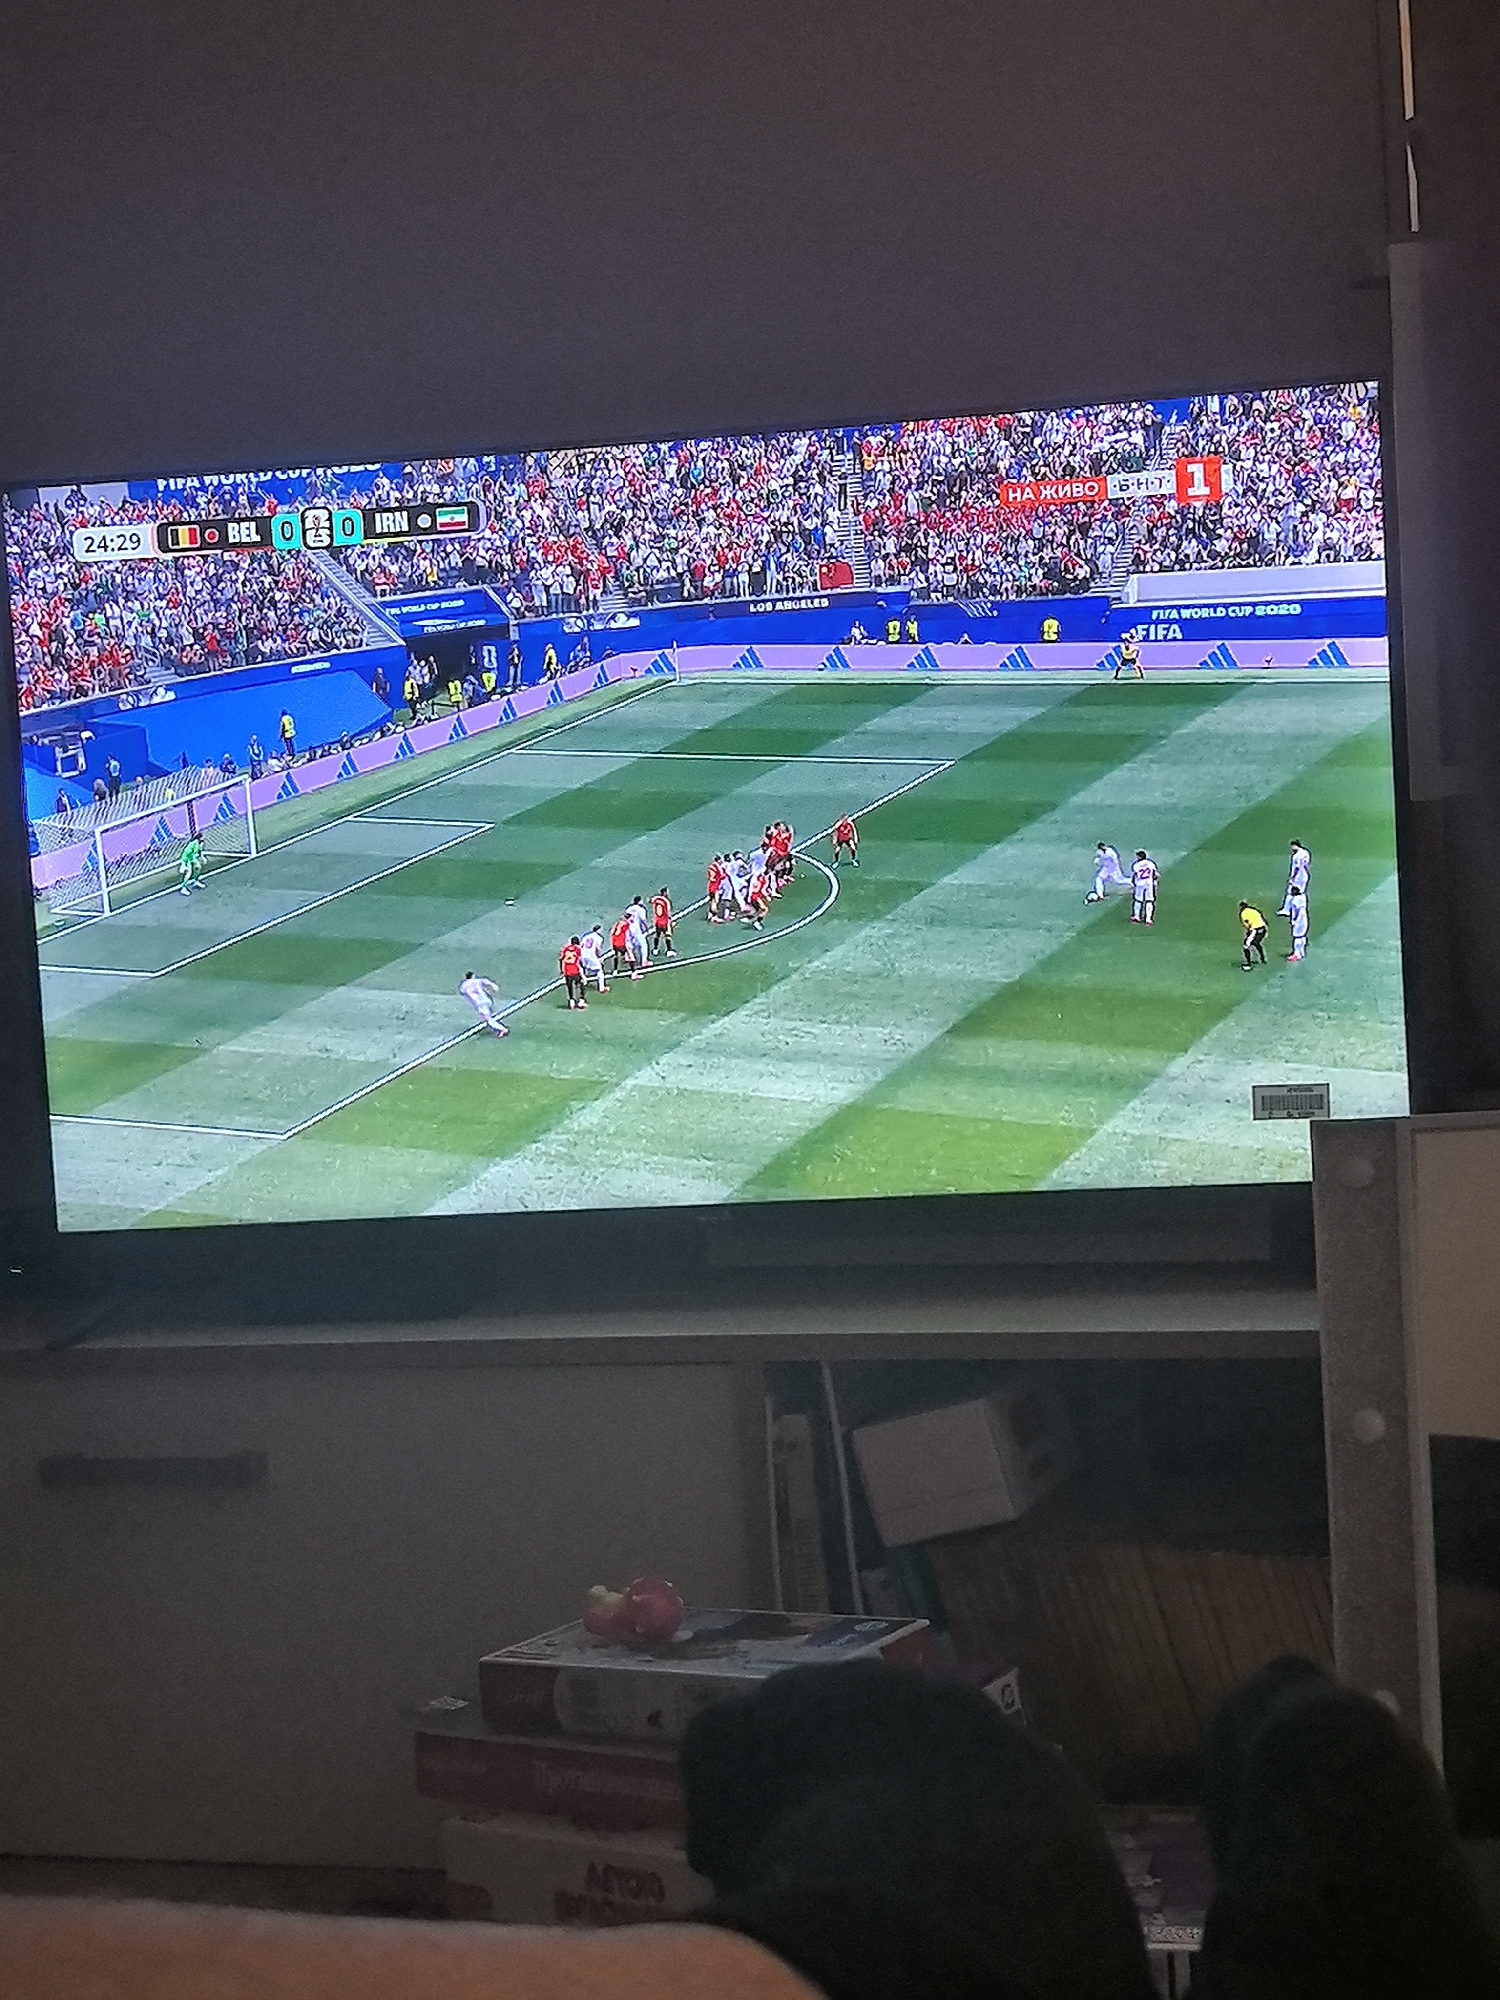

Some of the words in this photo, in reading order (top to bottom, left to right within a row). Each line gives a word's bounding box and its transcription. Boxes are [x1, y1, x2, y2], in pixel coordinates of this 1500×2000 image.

[1008, 487, 1035, 502] НА
[1039, 481, 1099, 499] ЖИВО
[1186, 463, 1211, 497] 1
[226, 522, 261, 544] BEL
[280, 520, 294, 542] 0
[341, 516, 355, 538] 0
[374, 511, 410, 533] IRN
[83, 533, 141, 553] 24:29
[1151, 608, 1179, 621] FIFA
[1181, 606, 1226, 620] WORLD
[1228, 605, 1254, 618] CUP
[1136, 623, 1183, 640] FIFA
